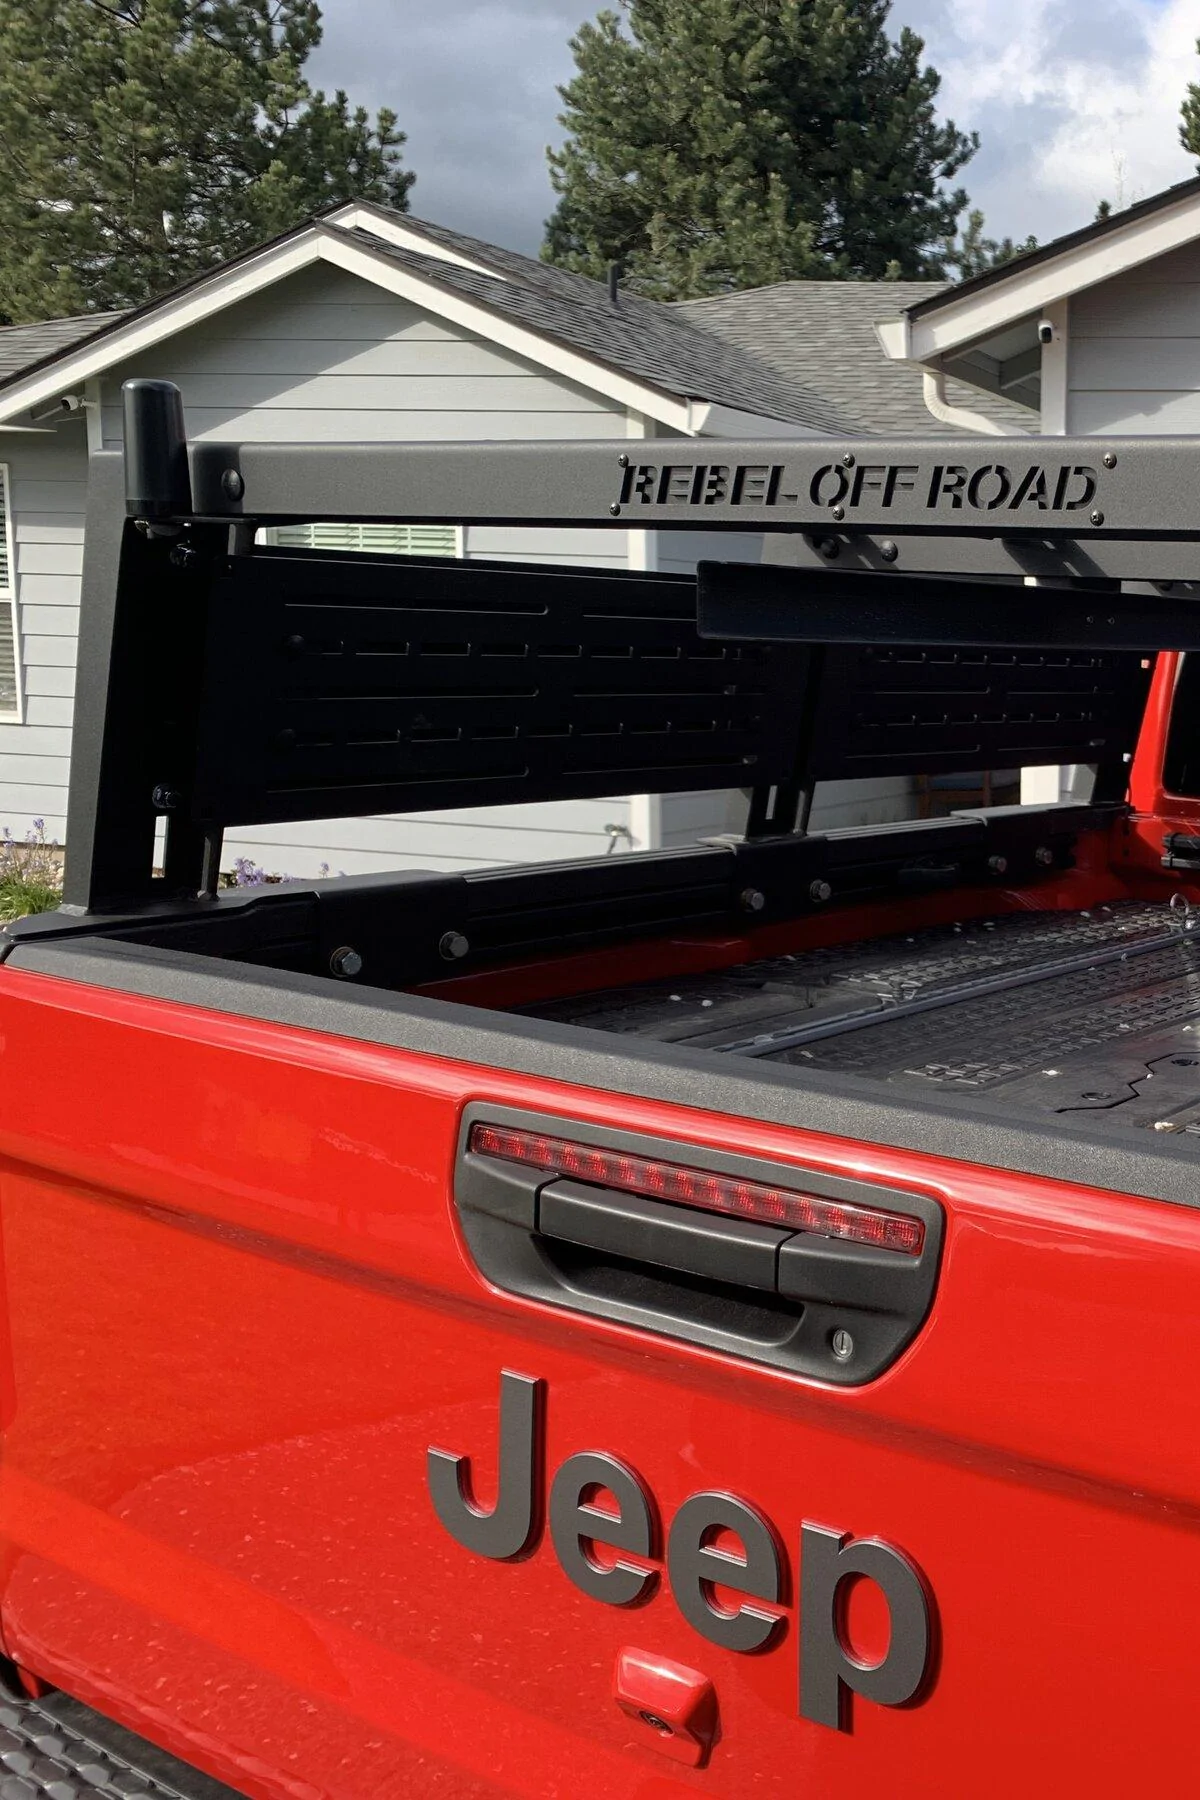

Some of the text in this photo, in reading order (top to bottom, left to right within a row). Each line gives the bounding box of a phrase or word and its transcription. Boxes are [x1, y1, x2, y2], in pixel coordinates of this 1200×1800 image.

[618, 463, 1098, 511] REBEL OFF ROAD
[427, 1367, 936, 1733] Jeep
